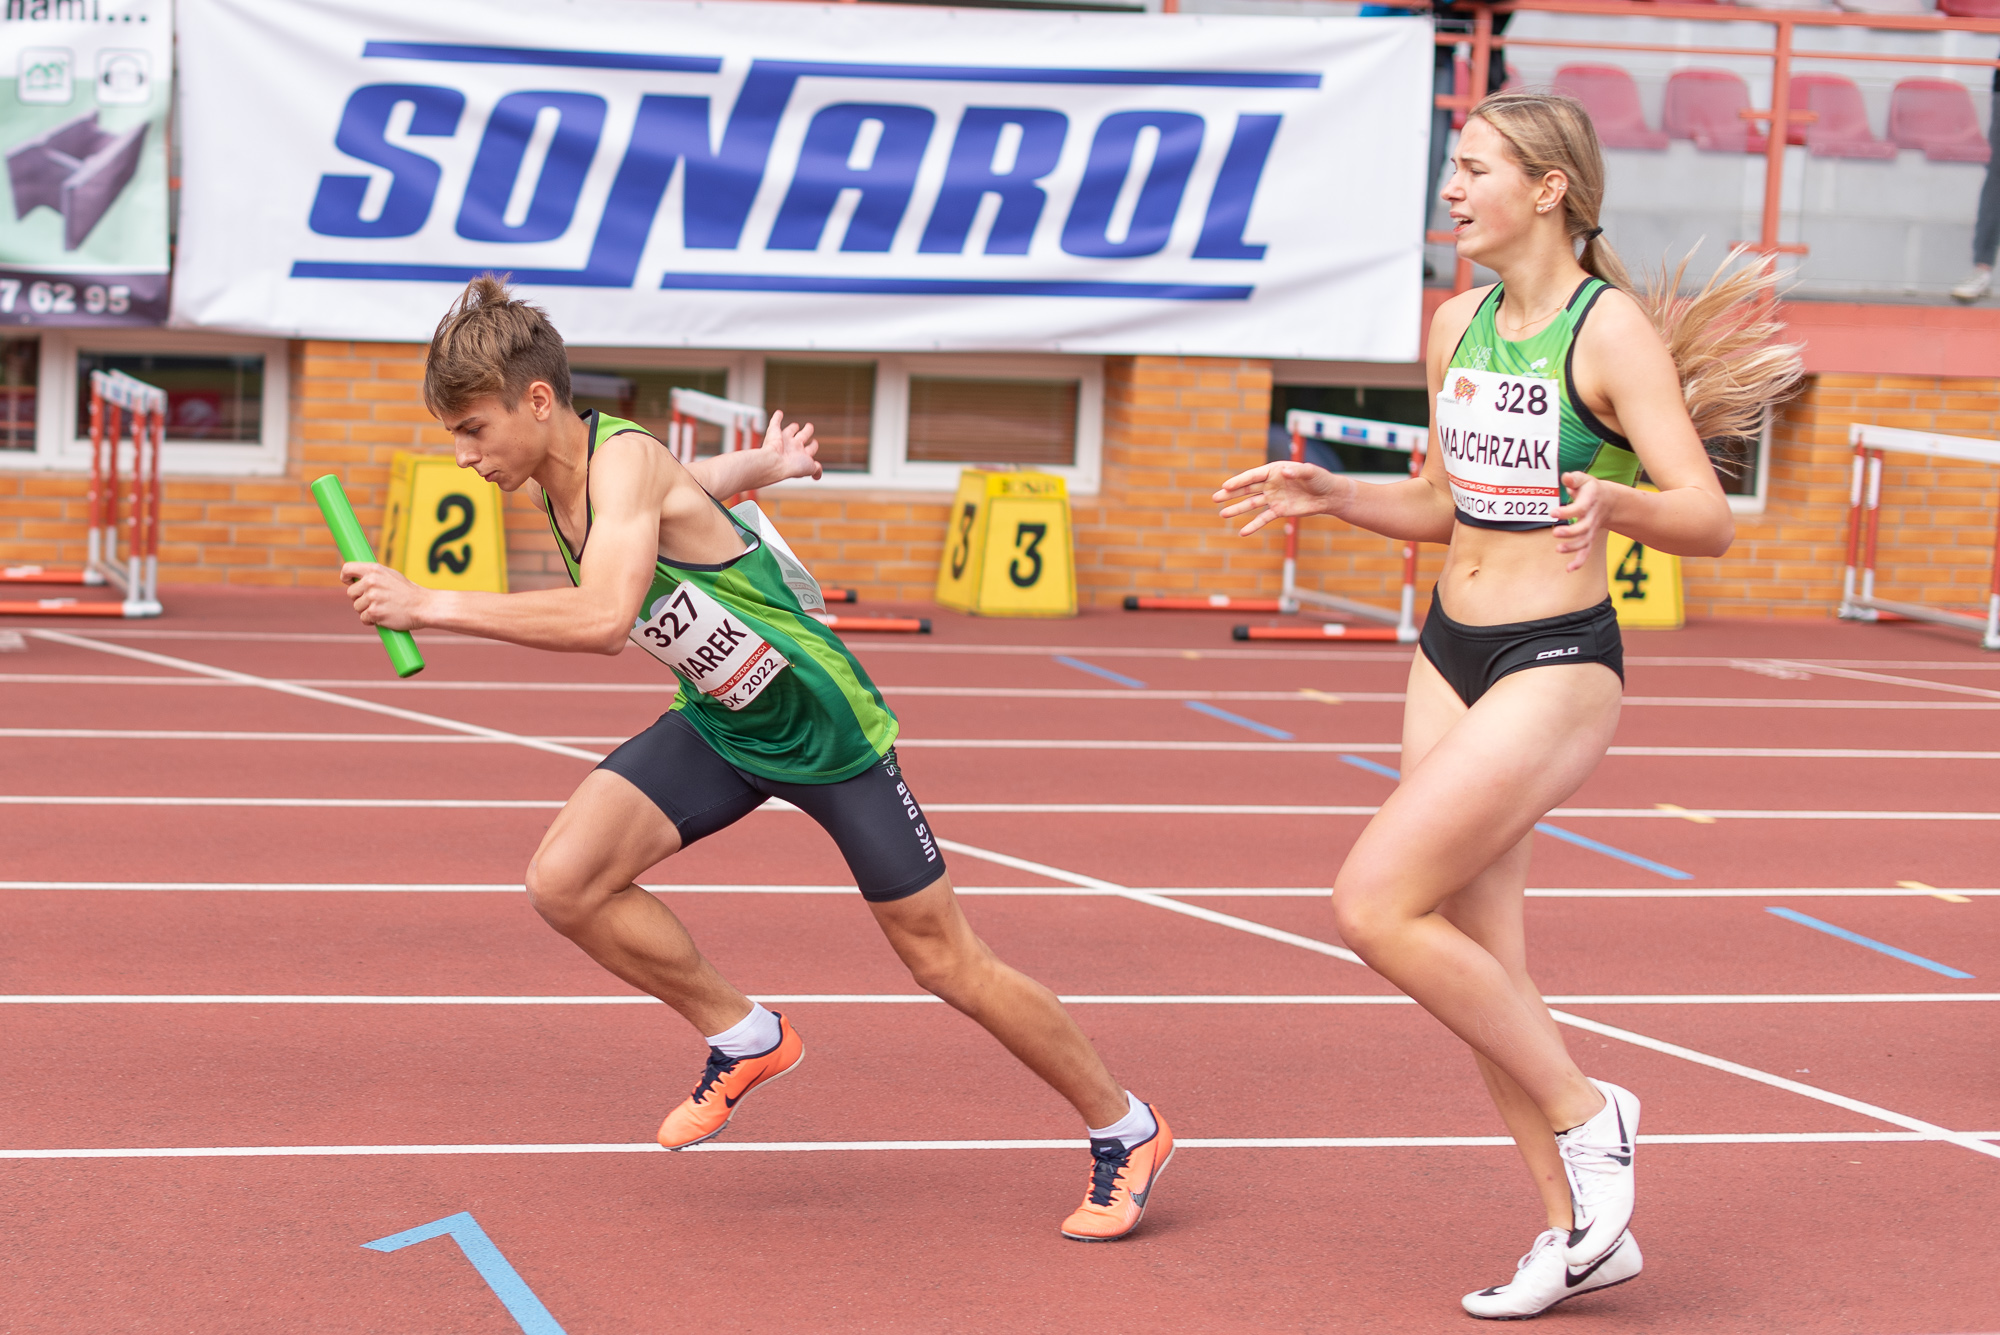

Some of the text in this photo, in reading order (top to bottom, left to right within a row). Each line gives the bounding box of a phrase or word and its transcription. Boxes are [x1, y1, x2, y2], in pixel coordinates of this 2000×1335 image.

[308, 58, 1284, 289] SONAROL
[29, 281, 76, 314] 62
[85, 285, 130, 314] 95
[1494, 381, 1548, 415] 328
[1439, 425, 1551, 470] MAJCHRZAK
[1503, 501, 1549, 515] 2022
[1507, 487, 1555, 495] SZTAFETACH
[428, 493, 475, 574] 2
[1009, 523, 1047, 588] 3
[1614, 540, 1649, 600] 4
[644, 590, 698, 648] 327
[733, 645, 767, 682] SZTAFETACH
[742, 658, 779, 695] 2022
[896, 781, 919, 820] DAB
[915, 823, 937, 863] UKS
